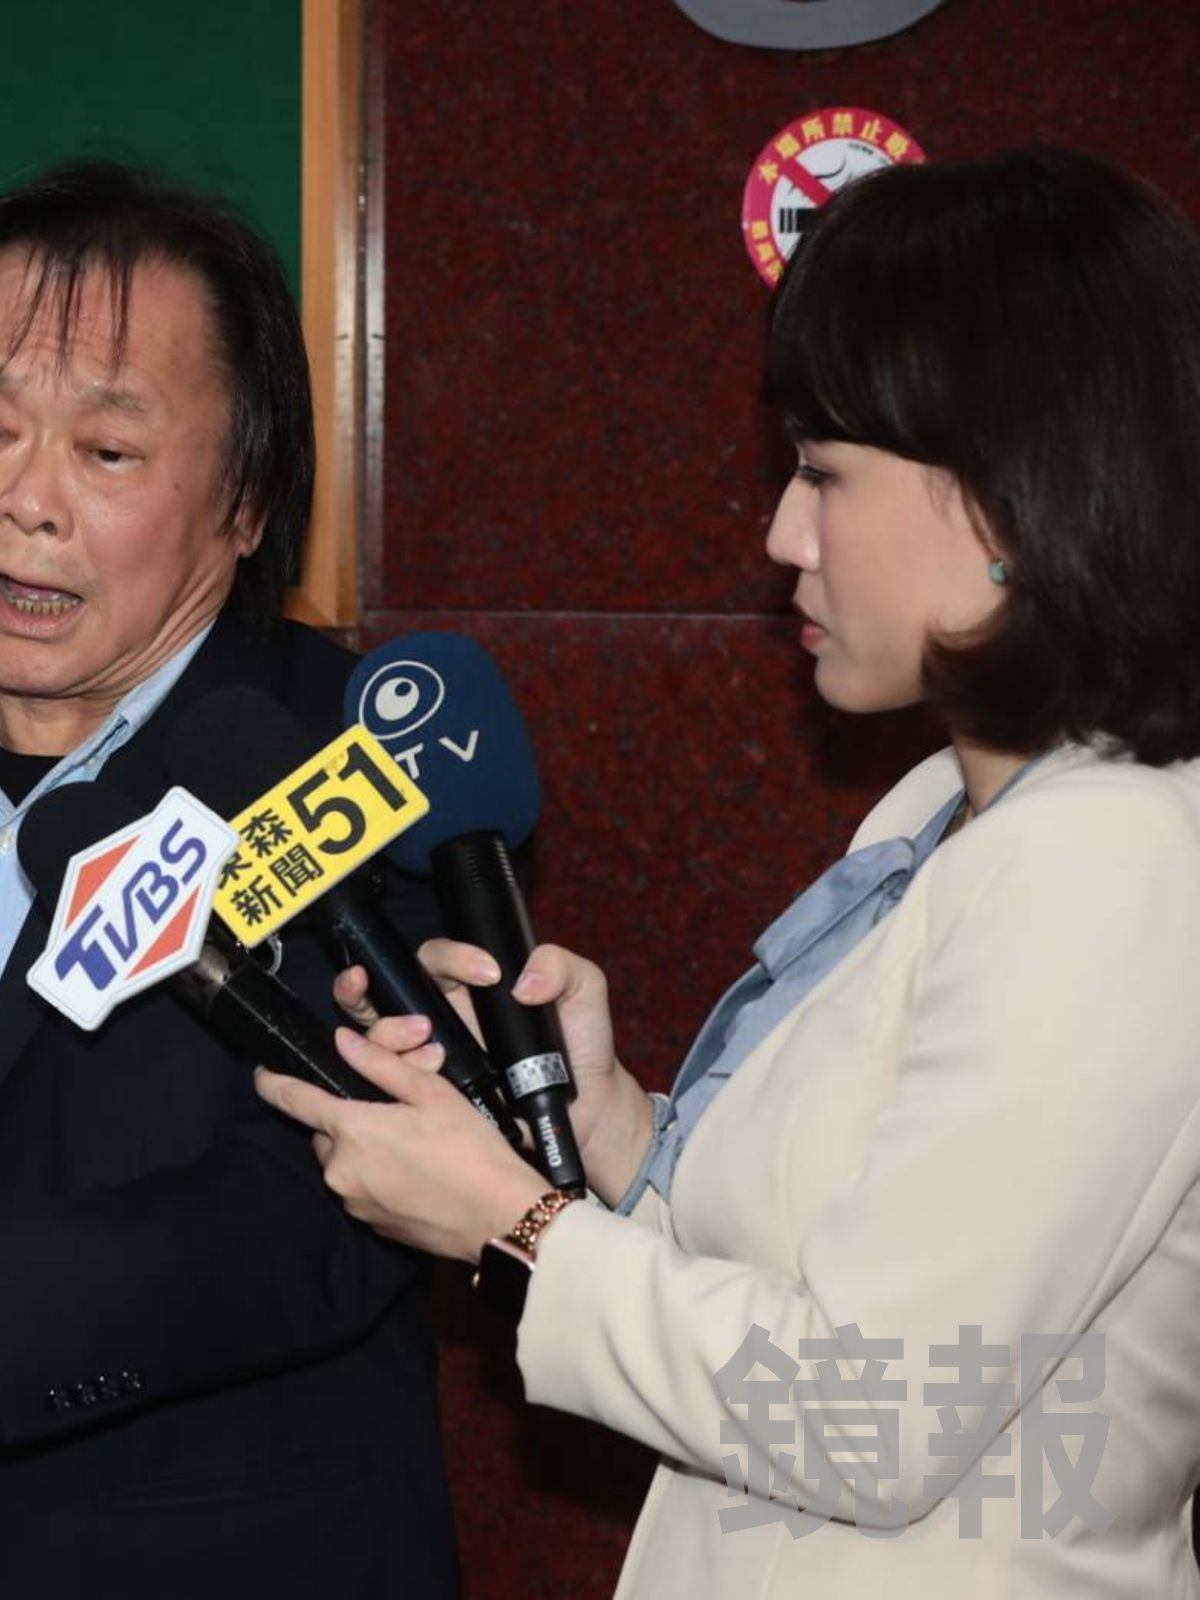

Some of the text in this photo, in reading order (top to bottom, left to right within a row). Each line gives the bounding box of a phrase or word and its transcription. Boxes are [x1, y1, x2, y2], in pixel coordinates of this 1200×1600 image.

[286, 741, 409, 856] 51
[54, 818, 208, 991] TVBS
[229, 842, 325, 927] 新聞
[537, 1115, 563, 1168] MIPRO
